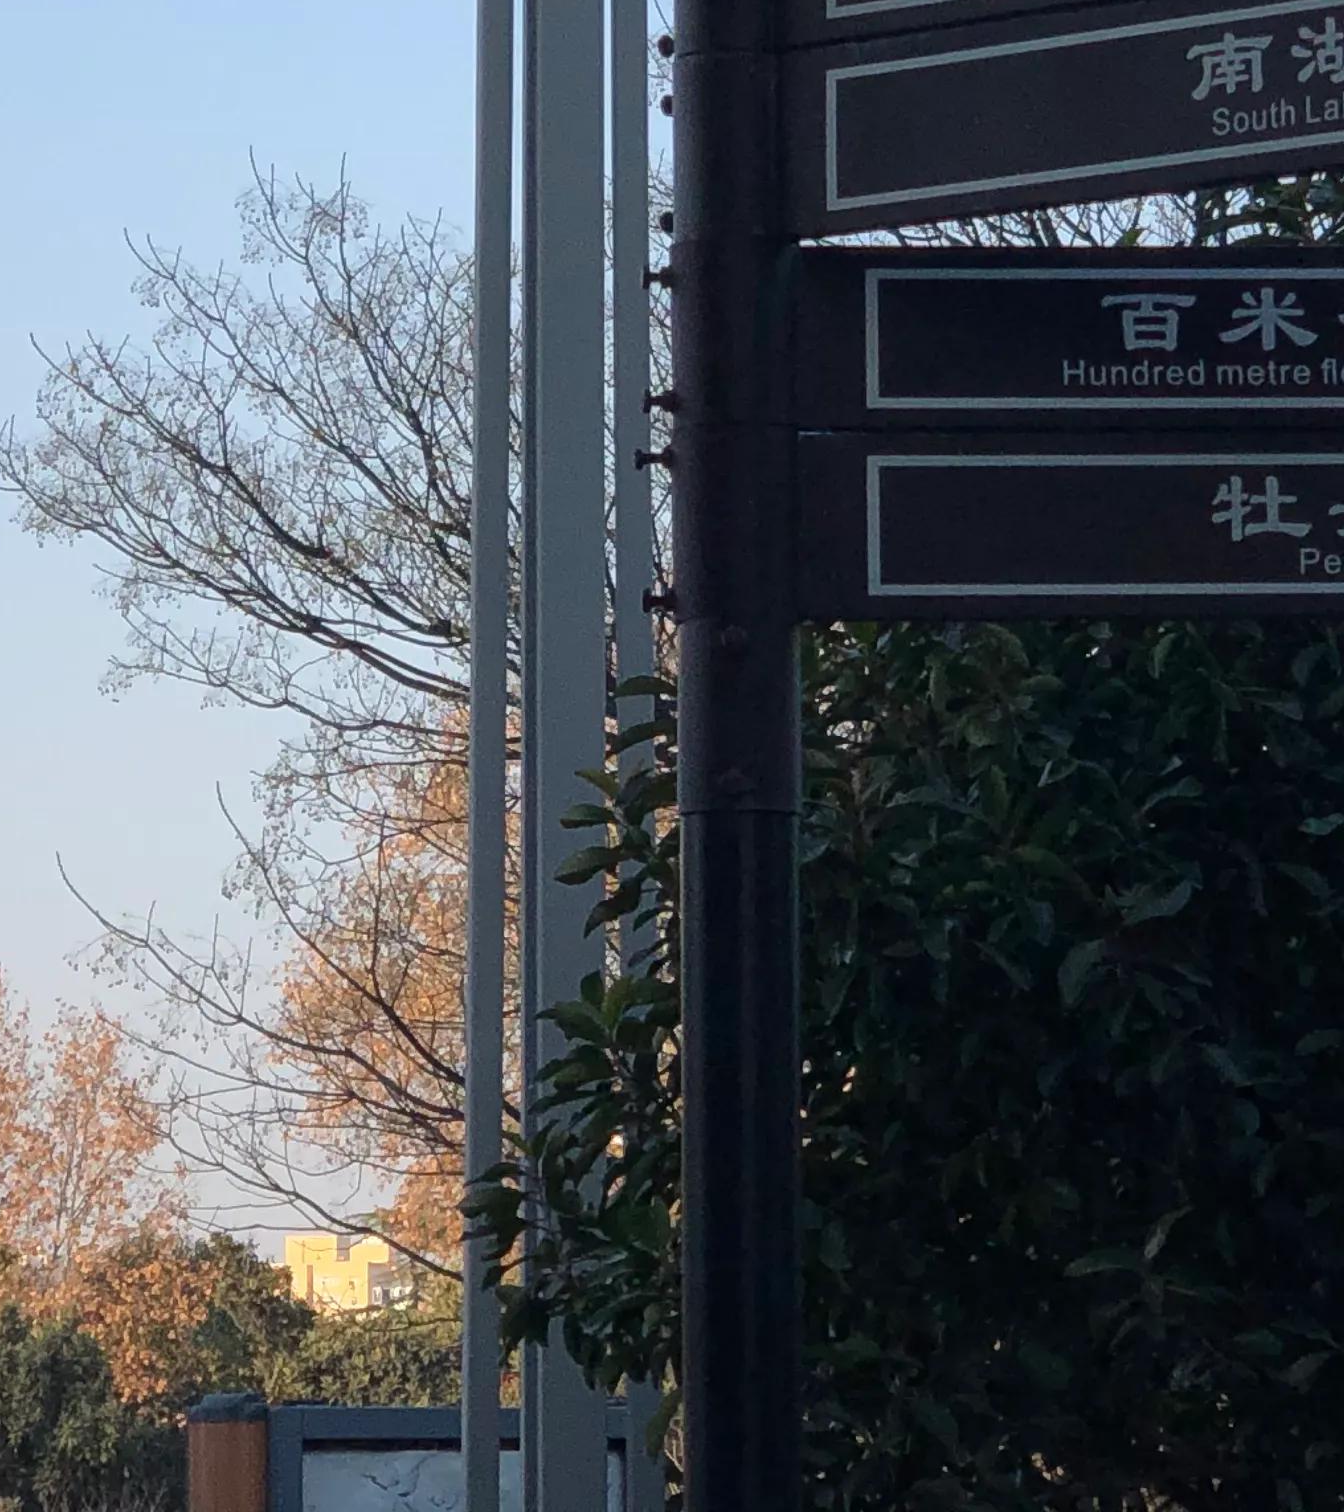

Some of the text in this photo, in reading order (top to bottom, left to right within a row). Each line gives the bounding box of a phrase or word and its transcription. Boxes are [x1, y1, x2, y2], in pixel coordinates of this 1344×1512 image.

[1211, 96, 1297, 136] South
[1062, 359, 1205, 387] Hundred
[1216, 360, 1312, 386] metre
